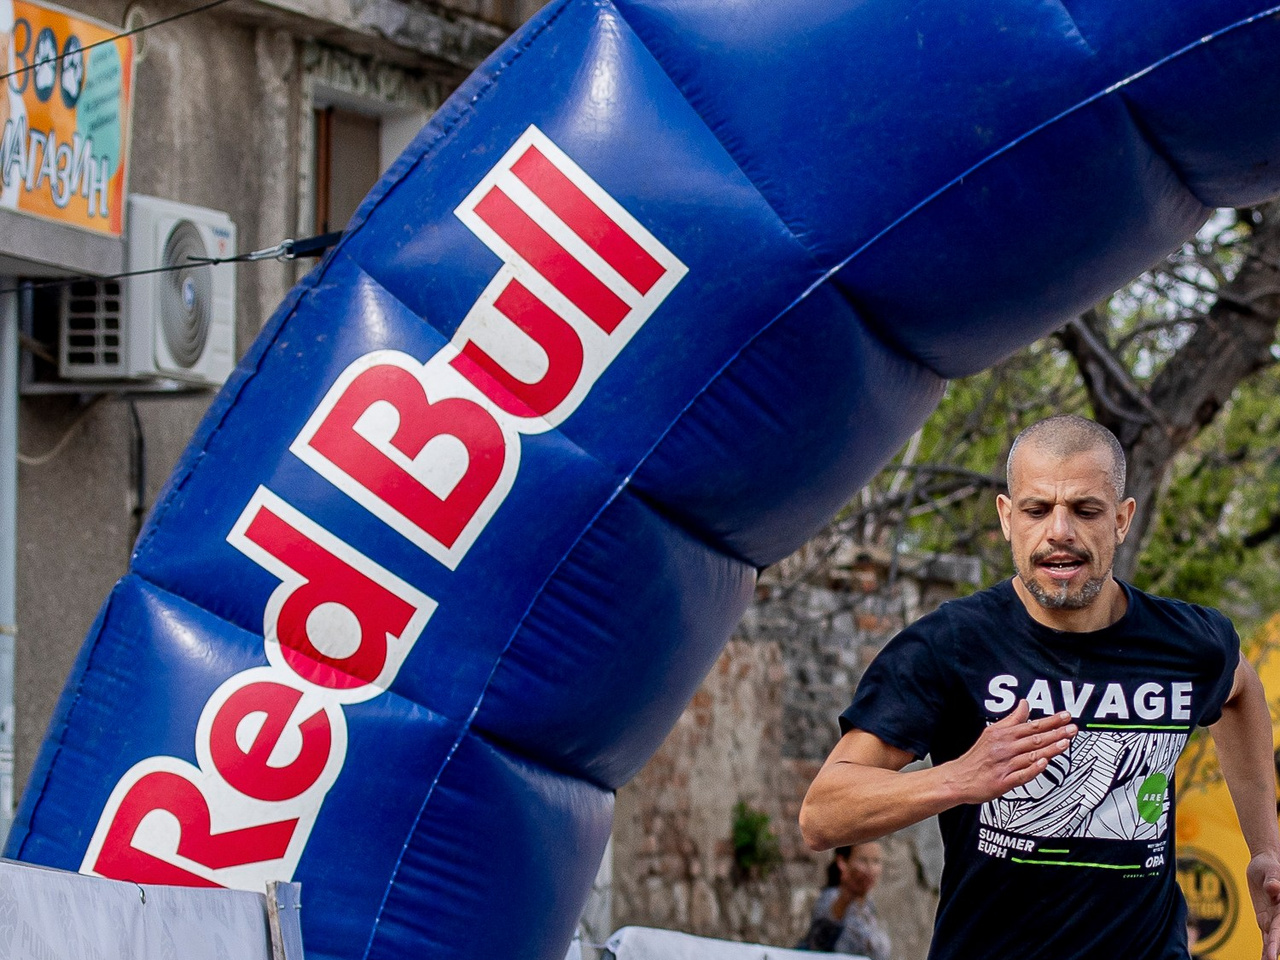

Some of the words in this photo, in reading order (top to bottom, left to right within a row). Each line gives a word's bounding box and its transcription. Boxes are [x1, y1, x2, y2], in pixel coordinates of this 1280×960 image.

[86, 494, 430, 889] Red
[299, 135, 678, 560] Bull
[984, 674, 1193, 720] SAVAGE
[977, 839, 1008, 858] EUPH
[978, 827, 1036, 852] SUMMER
